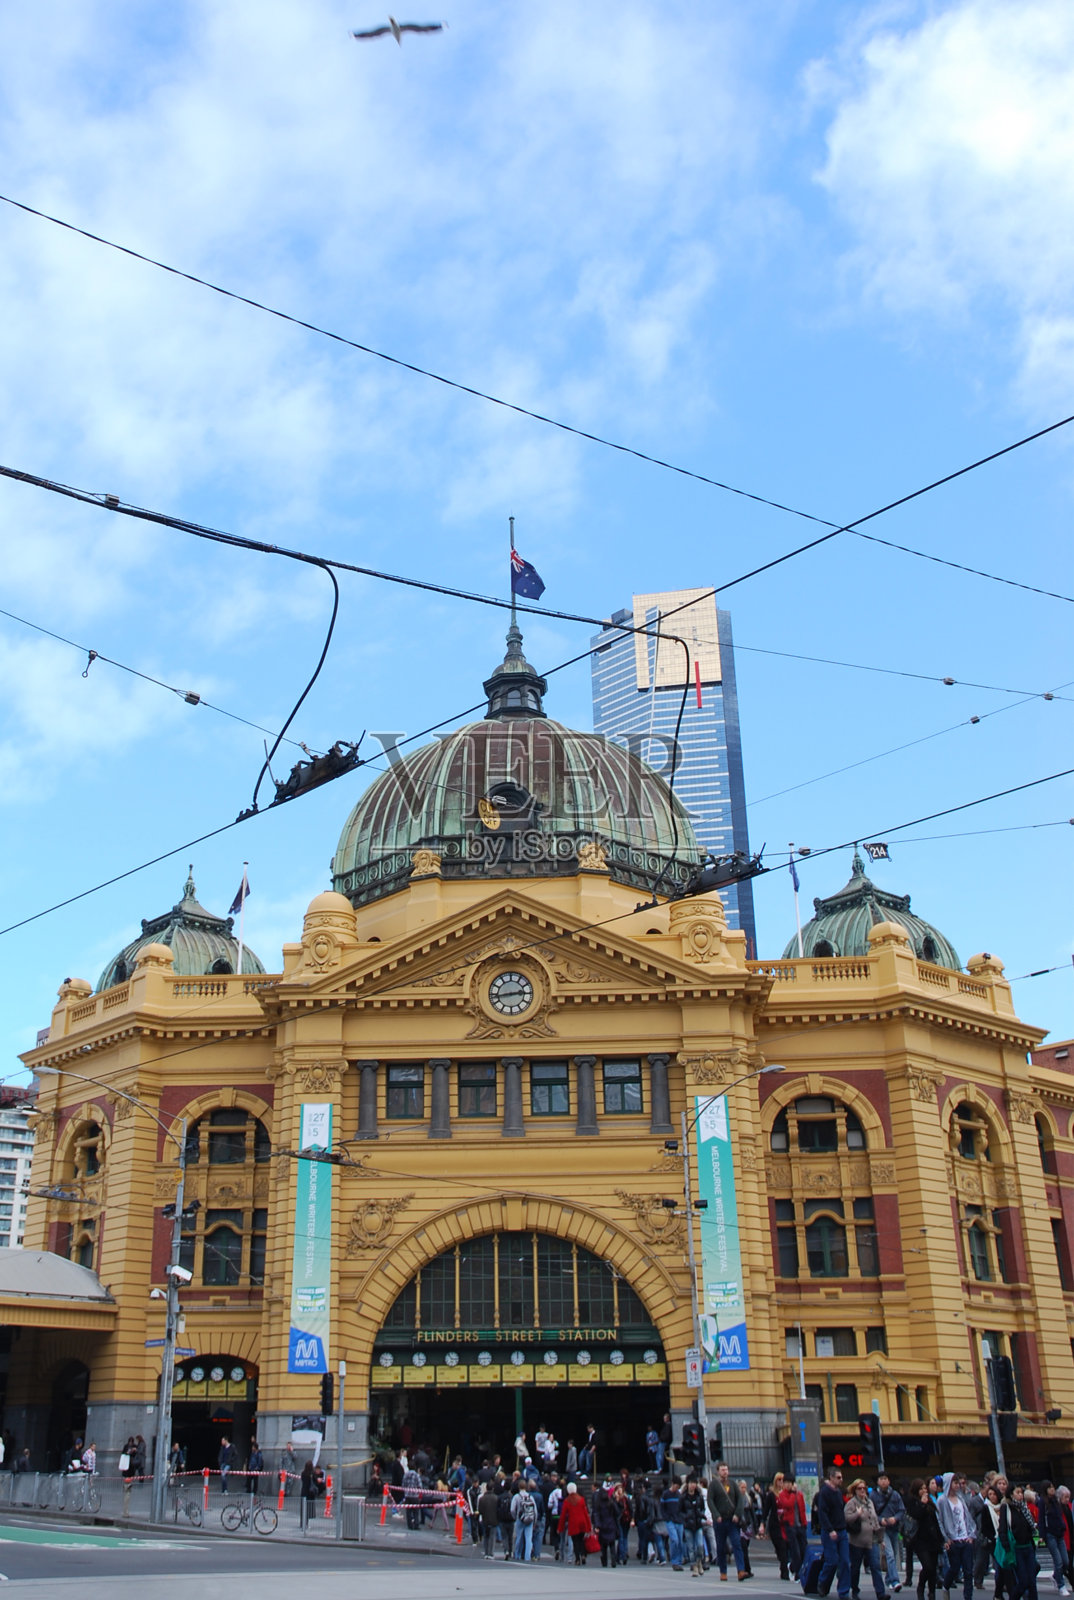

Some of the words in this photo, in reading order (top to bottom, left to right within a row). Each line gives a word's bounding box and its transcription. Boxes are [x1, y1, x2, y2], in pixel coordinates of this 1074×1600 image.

[870, 846, 886, 857] 214
[313, 1112, 325, 1122] 27
[709, 1105, 721, 1115] 27
[312, 1127, 319, 1137] 5
[710, 1120, 717, 1130] 5
[711, 1145, 722, 1195] MELBOURNE
[309, 1160, 318, 1201] ELBOURNE
[715, 1197, 725, 1234] WRITERS
[304, 1241, 315, 1279] FESTIVAL
[718, 1236, 728, 1273] FESTIVAL
[417, 1330, 480, 1343] FLINDERS
[496, 1329, 544, 1342] STREET
[558, 1328, 617, 1341] STATION
